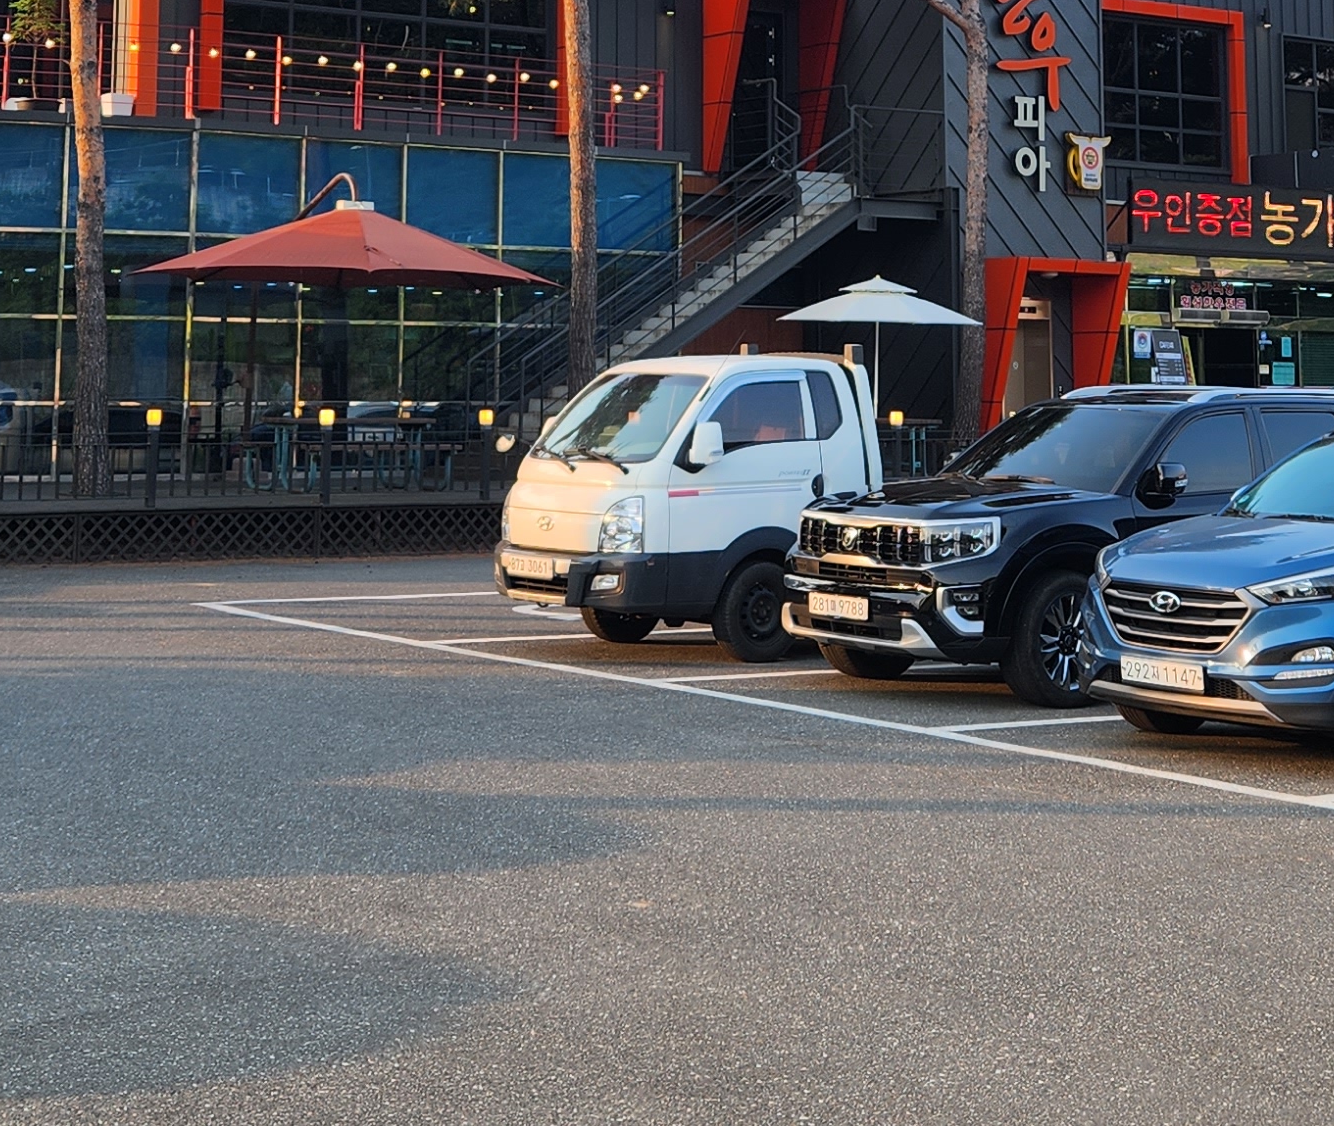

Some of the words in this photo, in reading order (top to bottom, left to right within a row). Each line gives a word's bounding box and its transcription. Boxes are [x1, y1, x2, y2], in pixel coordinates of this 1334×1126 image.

[1013, 95, 1051, 192] 피아
[1131, 189, 1253, 238] 우인증점
[838, 599, 864, 616] 9788
[1126, 660, 1160, 681] 292저
[1163, 665, 1198, 686] 1147
